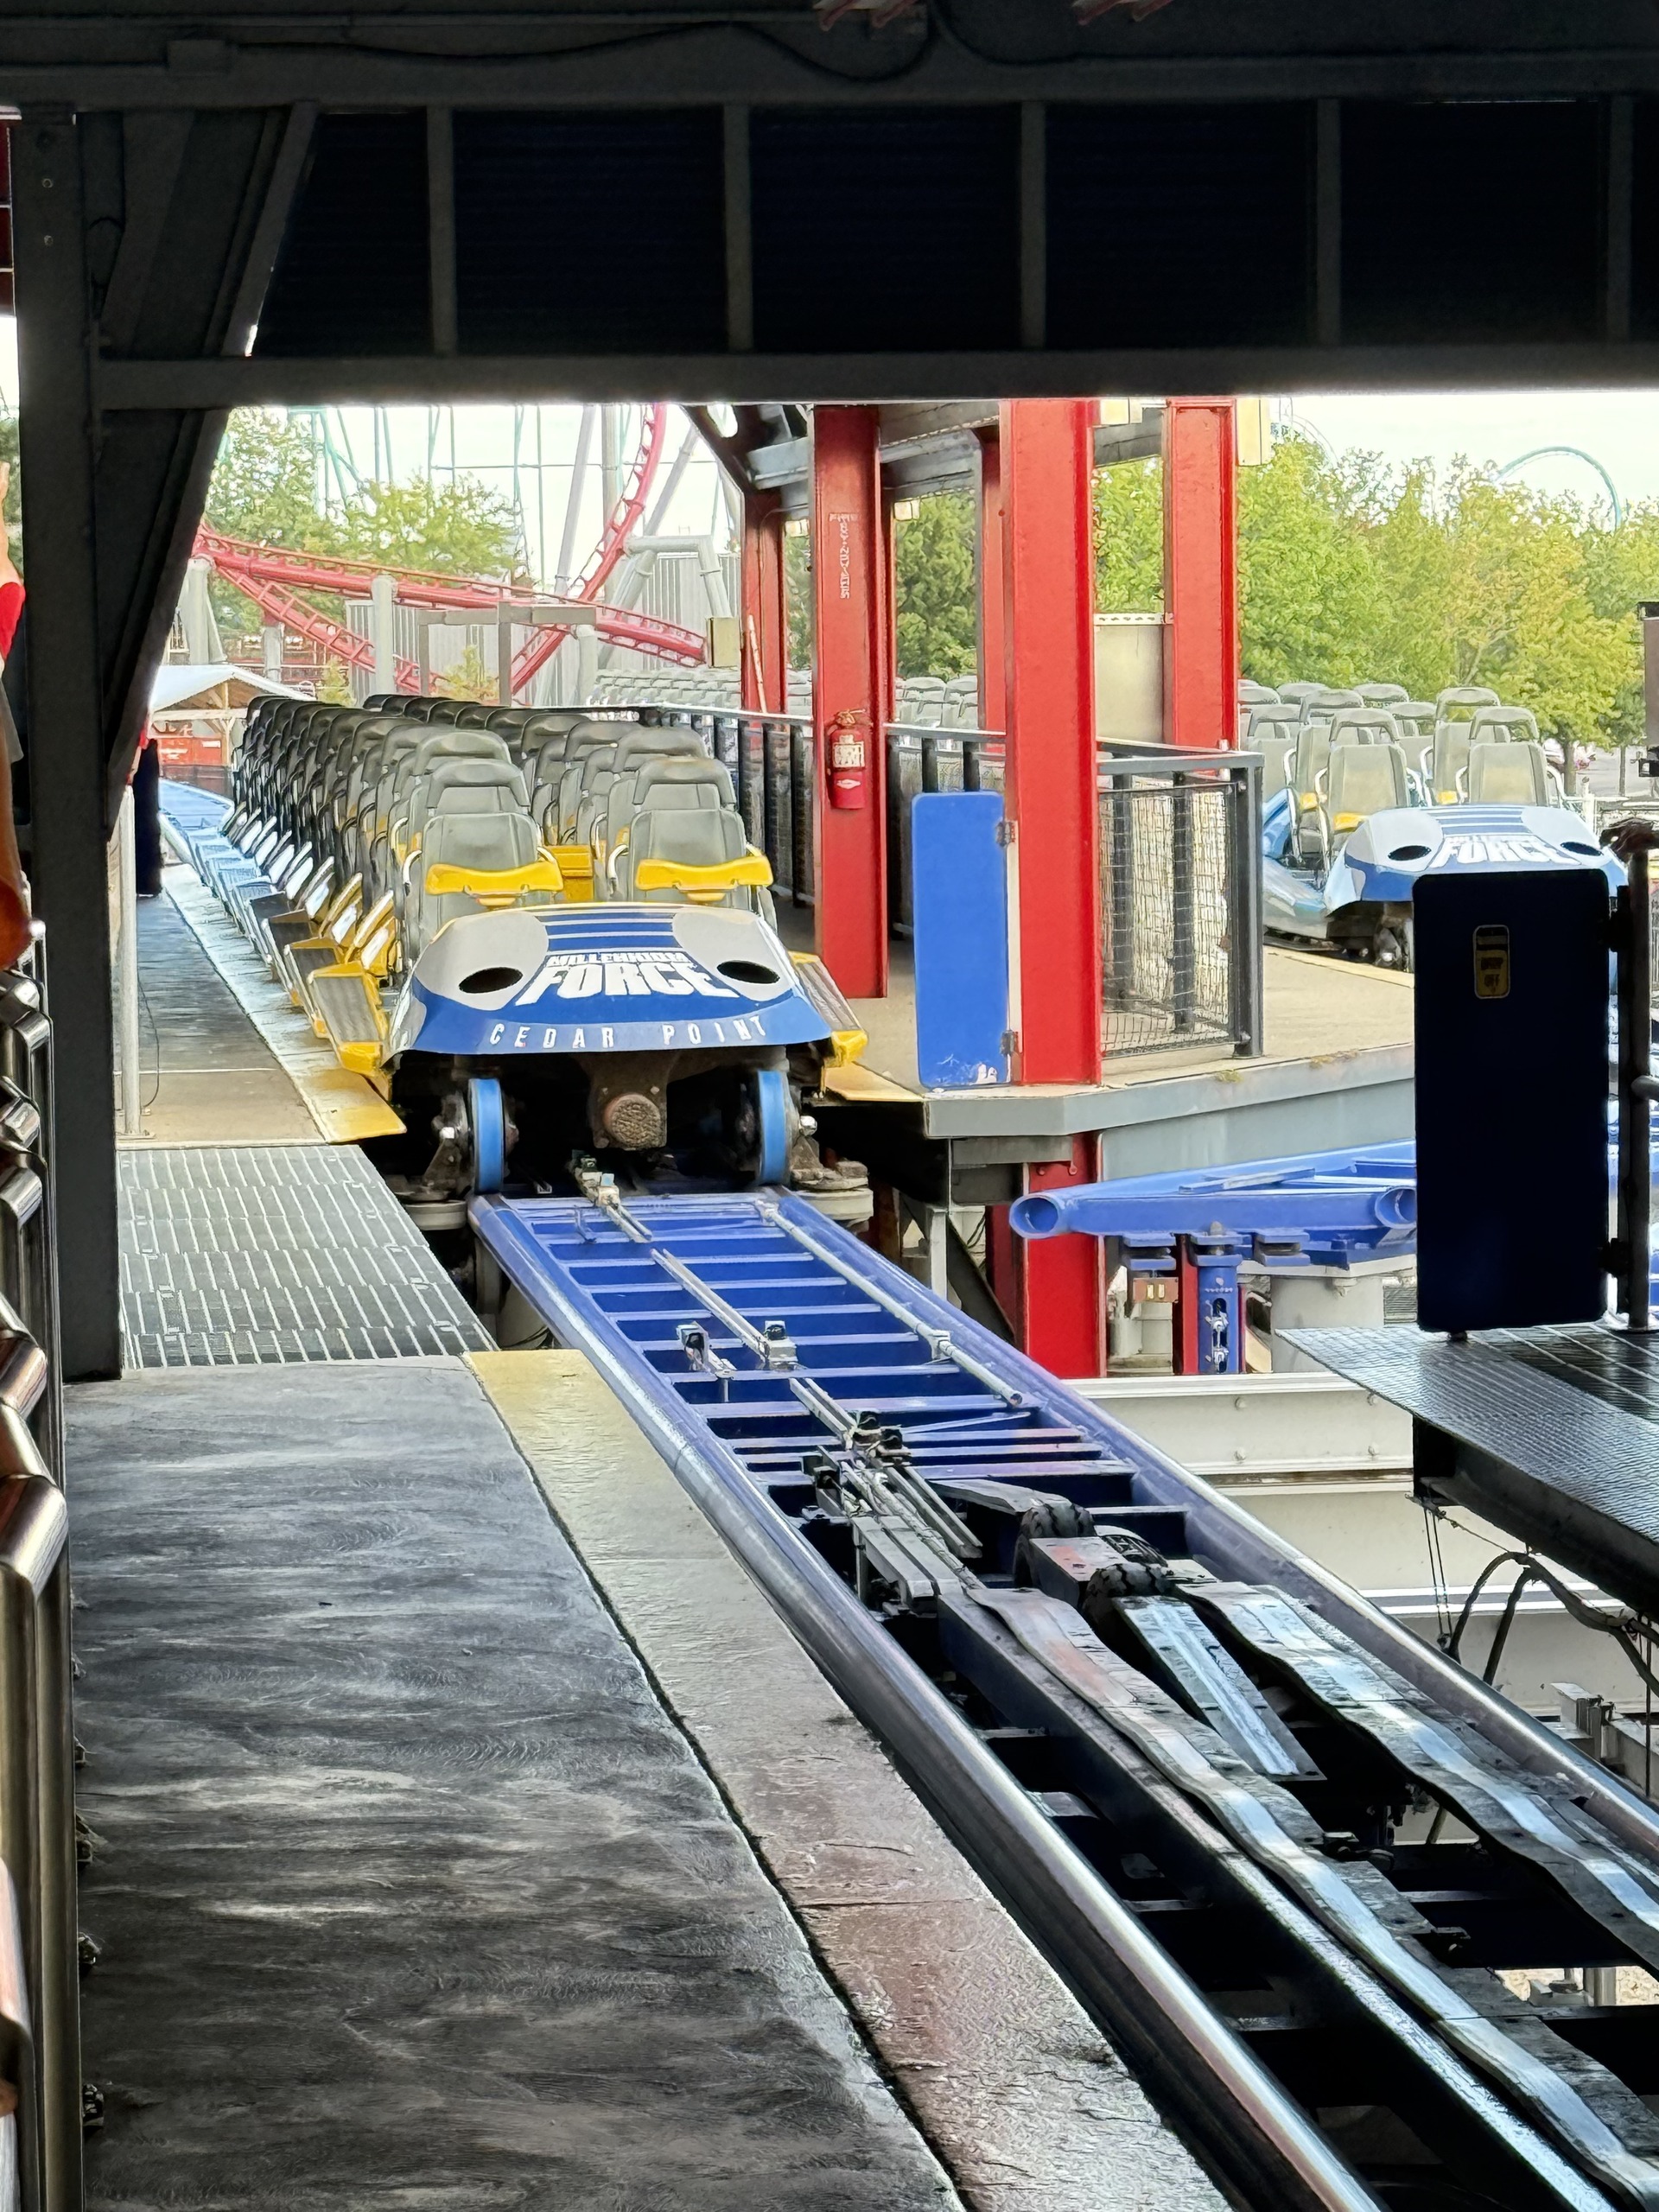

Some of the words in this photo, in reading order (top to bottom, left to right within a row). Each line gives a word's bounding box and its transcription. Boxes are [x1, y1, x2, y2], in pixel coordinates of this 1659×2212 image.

[514, 962, 741, 1007] FORCE
[489, 1023, 614, 1048] CEDAR
[663, 1014, 766, 1046] POINT
